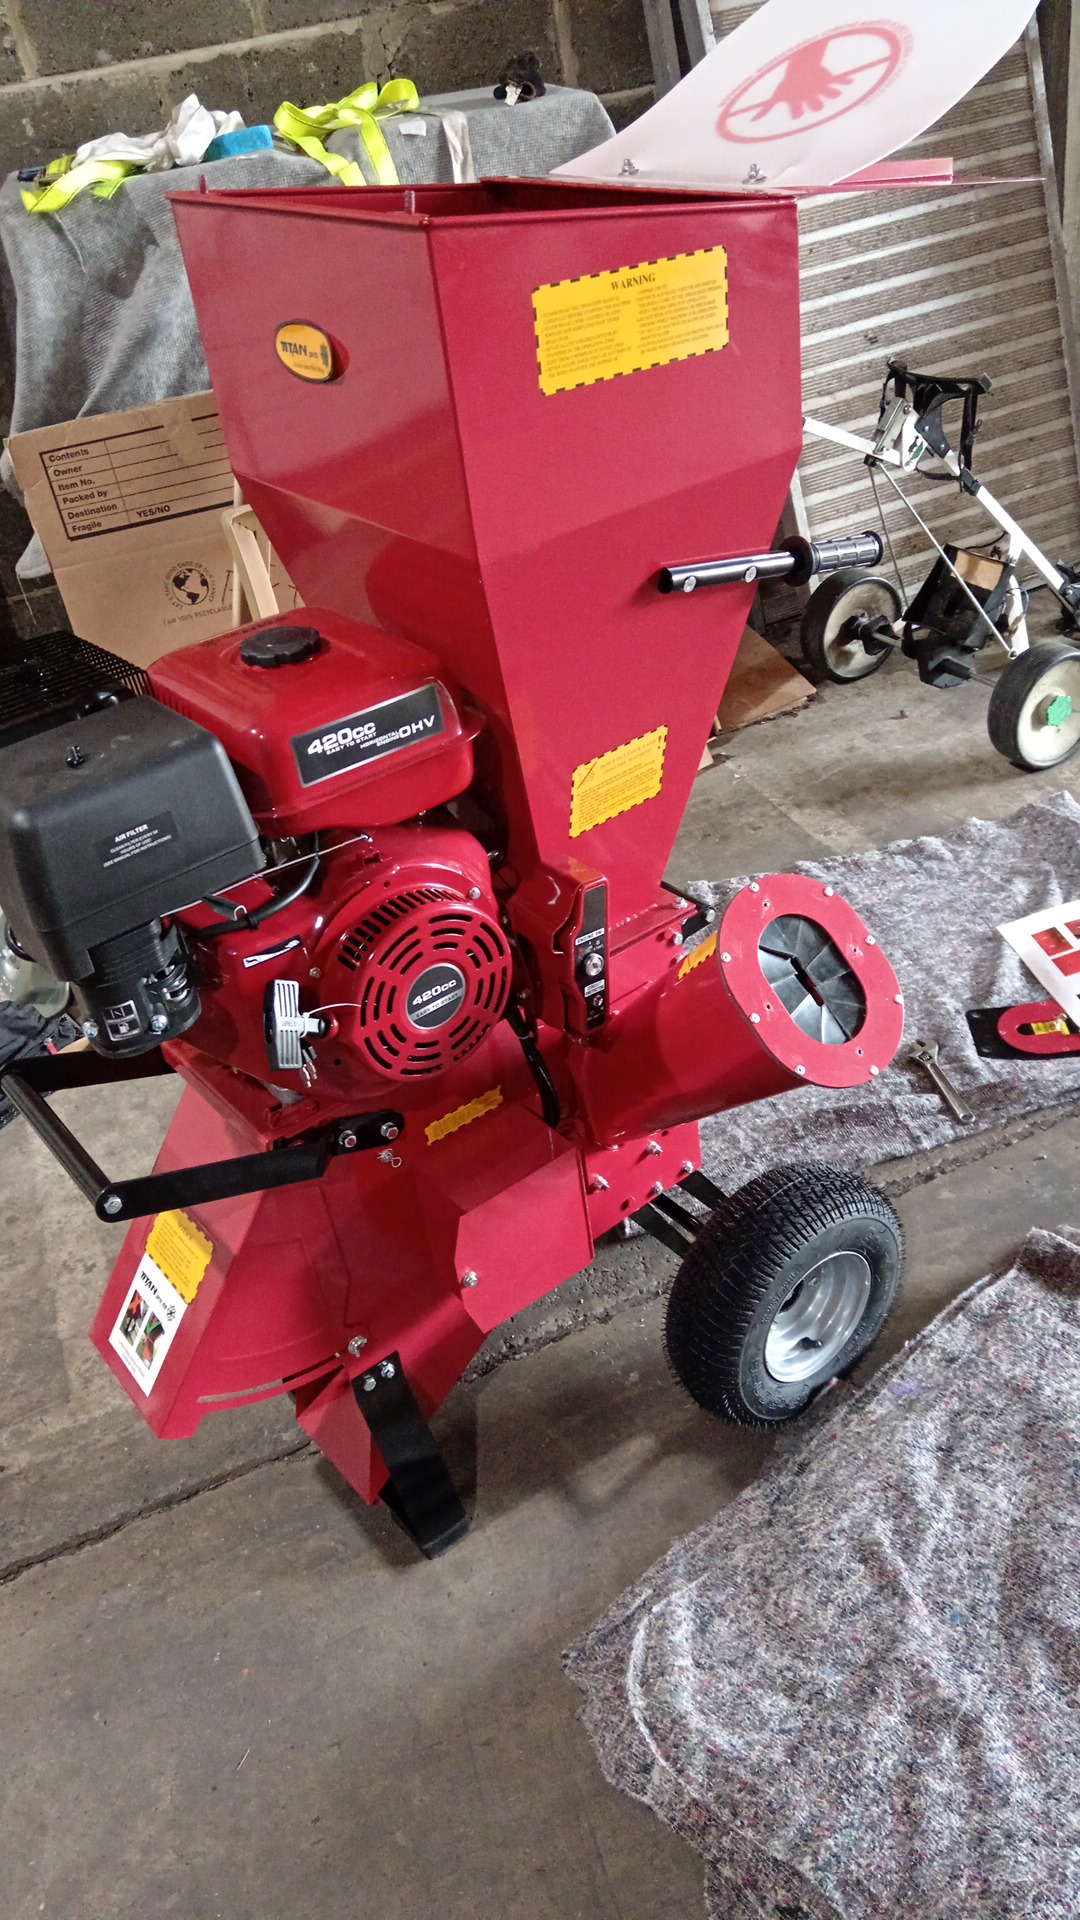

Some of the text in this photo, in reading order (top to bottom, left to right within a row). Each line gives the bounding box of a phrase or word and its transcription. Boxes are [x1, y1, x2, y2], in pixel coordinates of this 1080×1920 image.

[611, 272, 656, 291] WARNING
[280, 340, 307, 357] TITAN
[48, 448, 89, 462] Contents
[53, 465, 82, 477] Owner
[58, 478, 96, 492] Item No.
[62, 489, 108, 504] Packed by
[67, 503, 118, 519] Destination
[136, 505, 171, 518] YES/NO
[72, 521, 102, 533] Fragile
[399, 715, 435, 738] OHV
[307, 722, 376, 755] 420cc
[326, 745, 345, 755] EASY
[356, 732, 376, 744] START
[360, 731, 399, 748] HORIZONTAL
[376, 734, 400, 747] ENGINE
[115, 824, 149, 843] AIR FILTER
[412, 979, 457, 1005] 420cc
[416, 1008, 430, 1017] EASY
[441, 993, 459, 1004] START
[140, 1270, 158, 1295] TITAN
